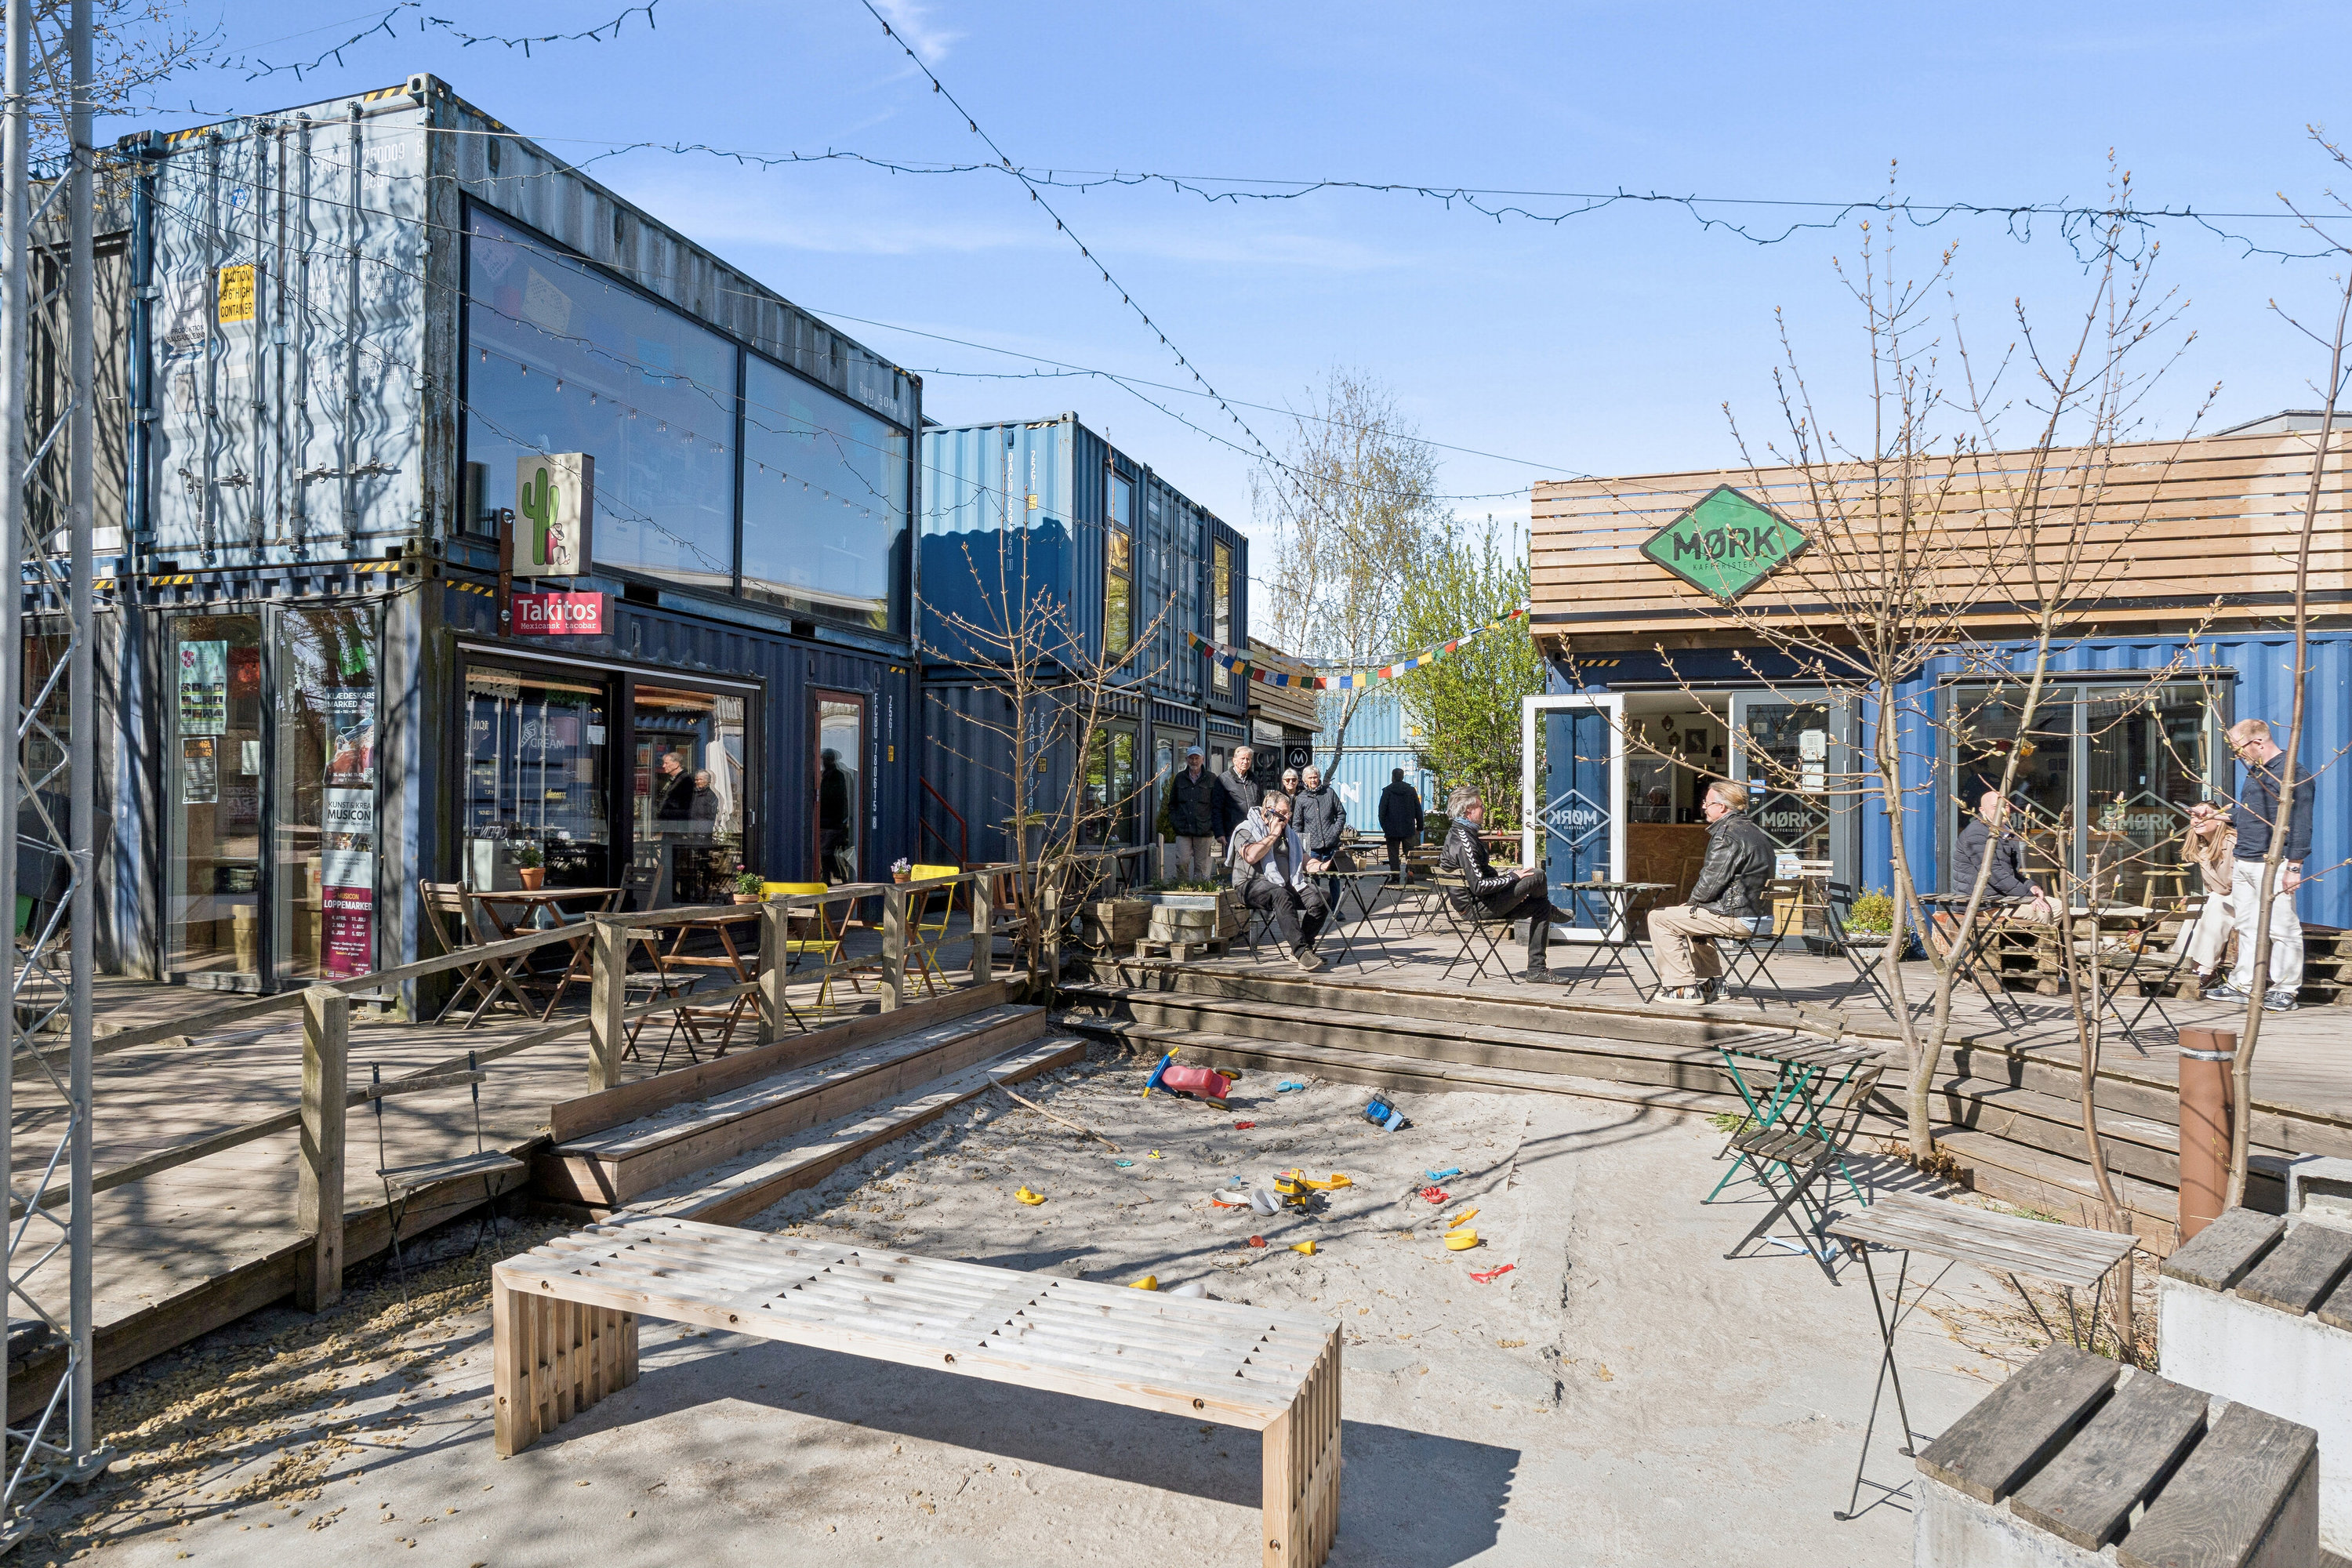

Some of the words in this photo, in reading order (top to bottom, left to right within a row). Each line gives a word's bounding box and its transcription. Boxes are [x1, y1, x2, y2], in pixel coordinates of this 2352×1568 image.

[363, 142, 405, 166] 250009
[417, 140, 423, 155] 6
[224, 269, 250, 284] CAUTION
[235, 286, 250, 298] HIGH
[310, 288, 332, 306] TARE
[220, 303, 252, 318] CONTAINER
[171, 325, 204, 334] PRODUKTION
[1673, 525, 1778, 561] MØRK
[518, 599, 597, 621] Takitos
[539, 725, 557, 736] ICE
[531, 739, 565, 750] CREAM
[327, 809, 371, 821] MUSICON
[1762, 811, 1813, 828] MØRK
[2009, 812, 2045, 829] ØRK
[2118, 813, 2177, 830] MØRK
[324, 899, 372, 911] LOPPEMARKED
